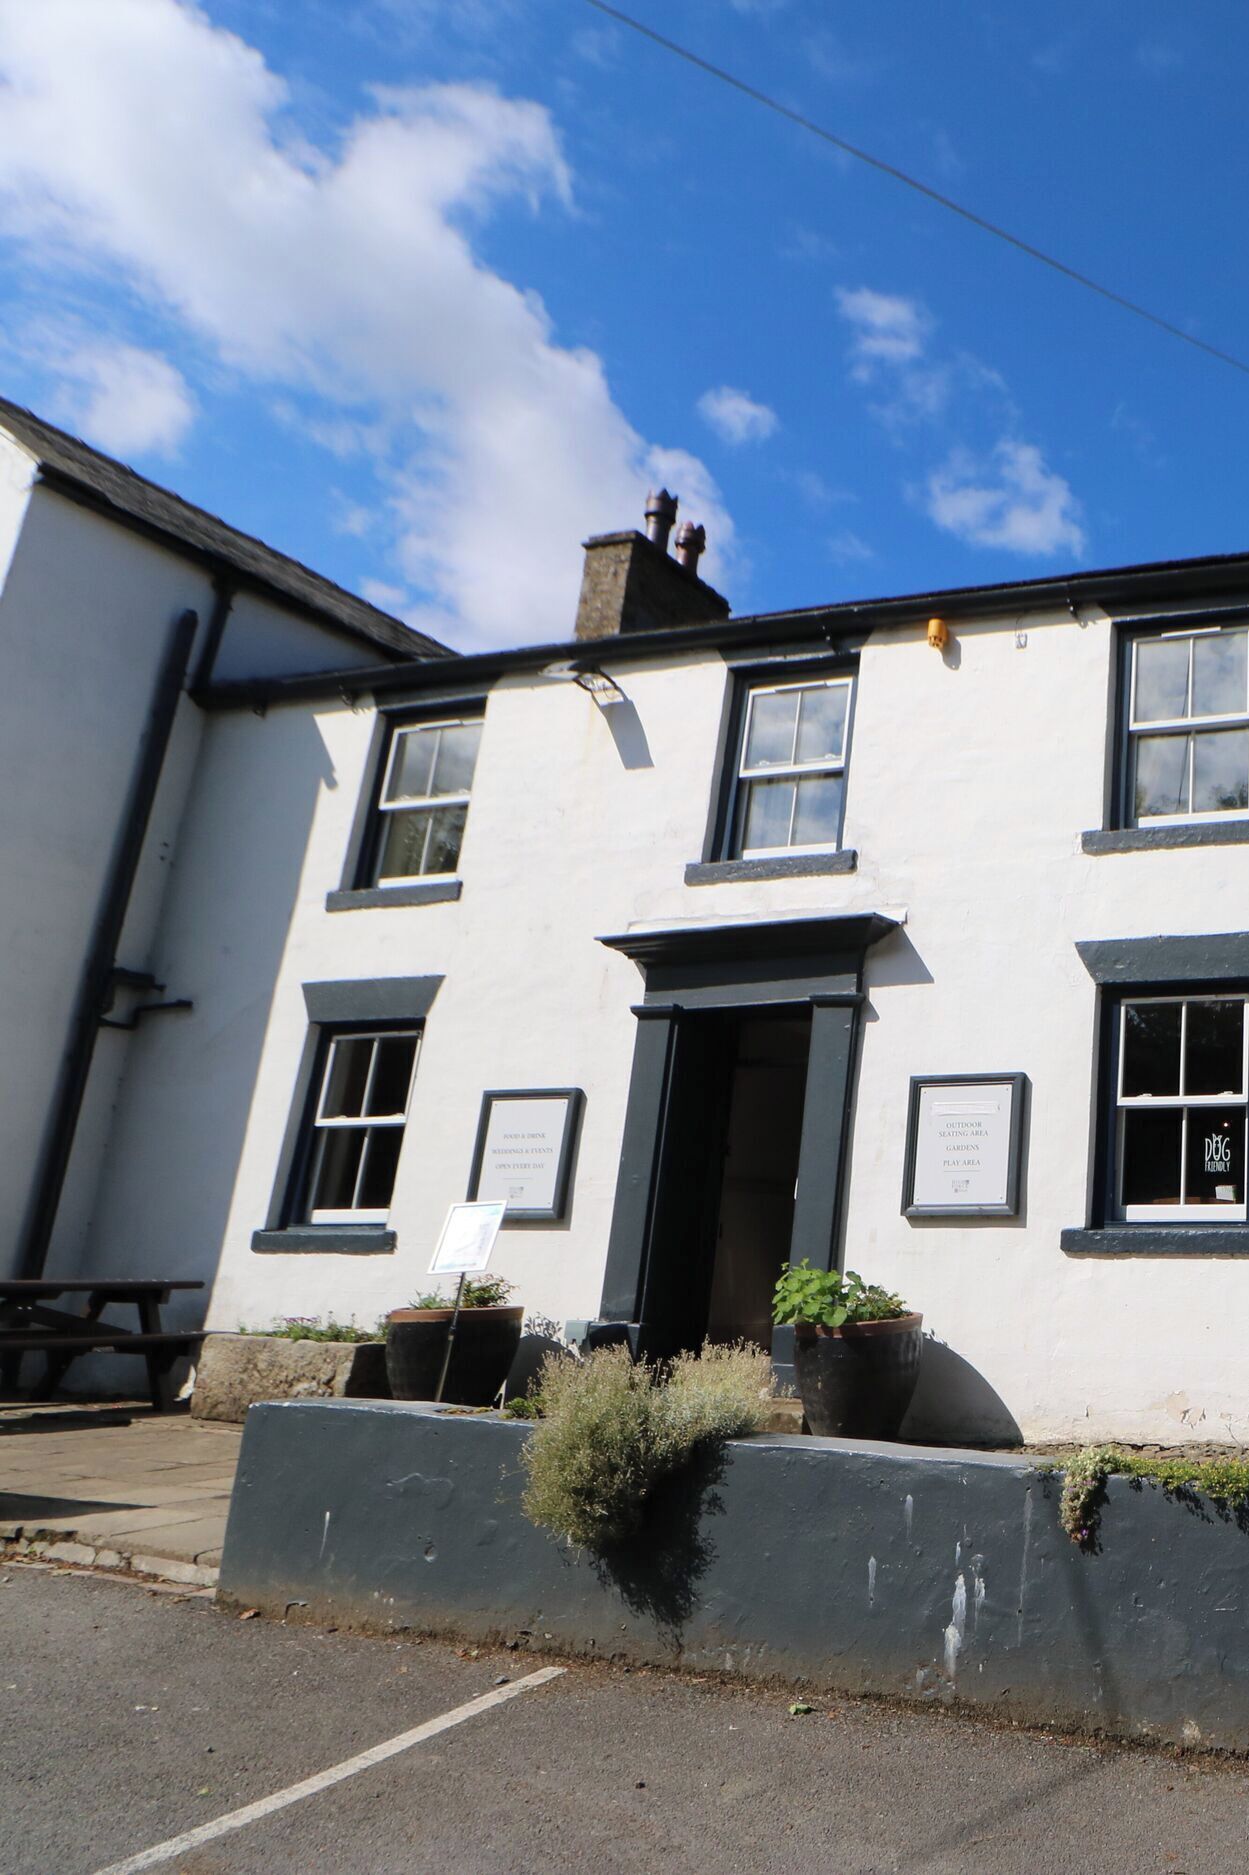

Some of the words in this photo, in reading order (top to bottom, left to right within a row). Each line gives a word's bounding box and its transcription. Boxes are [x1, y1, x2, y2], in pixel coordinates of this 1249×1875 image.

[1204, 1133, 1231, 1161] DOG
[943, 1159, 960, 1167] PLAY
[1204, 1160, 1231, 1172] FRIENDLY
